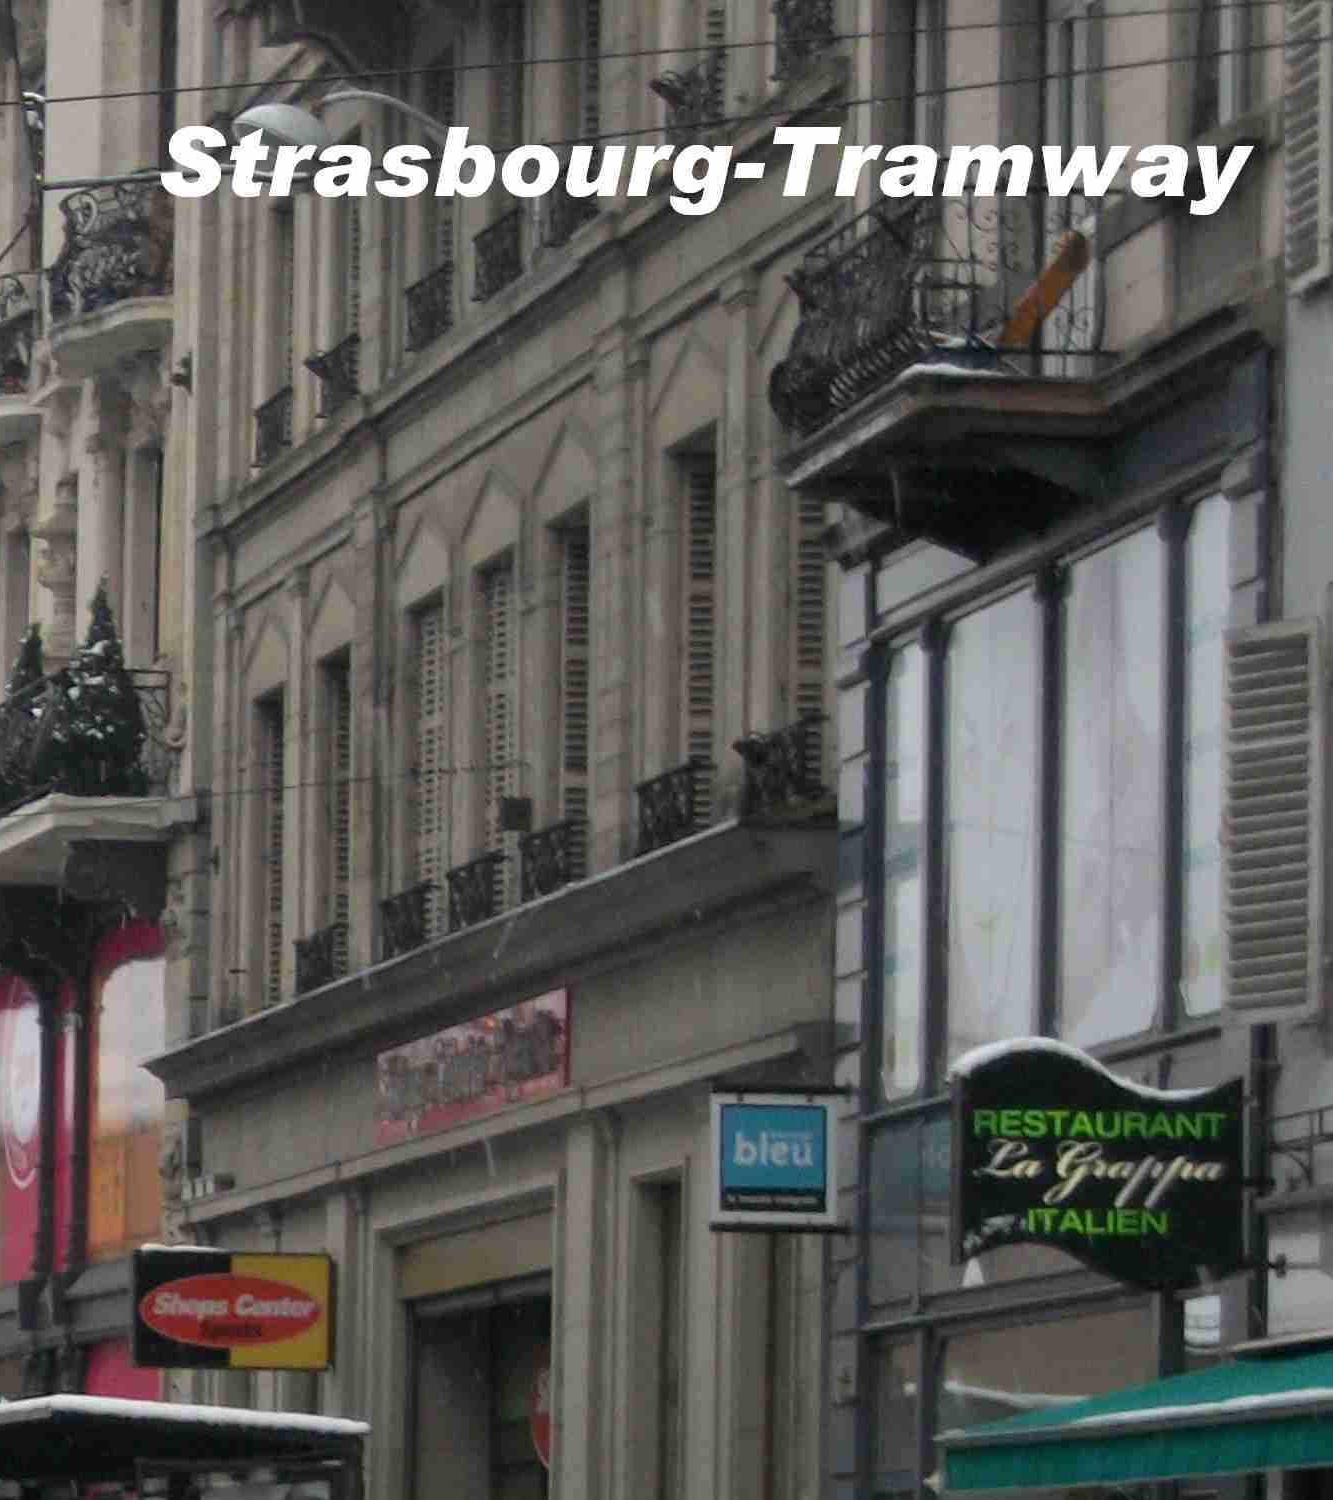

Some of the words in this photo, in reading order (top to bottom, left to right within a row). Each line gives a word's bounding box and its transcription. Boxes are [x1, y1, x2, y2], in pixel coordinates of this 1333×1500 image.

[972, 1108, 1226, 1138] RESTAURANT
[732, 1130, 815, 1167] bleu
[972, 1138, 1044, 1178] La
[1042, 1139, 1222, 1209] Grappa
[1027, 1207, 1171, 1236] ITALIEN
[153, 1291, 229, 1322] Shops
[234, 1293, 317, 1318] Center
